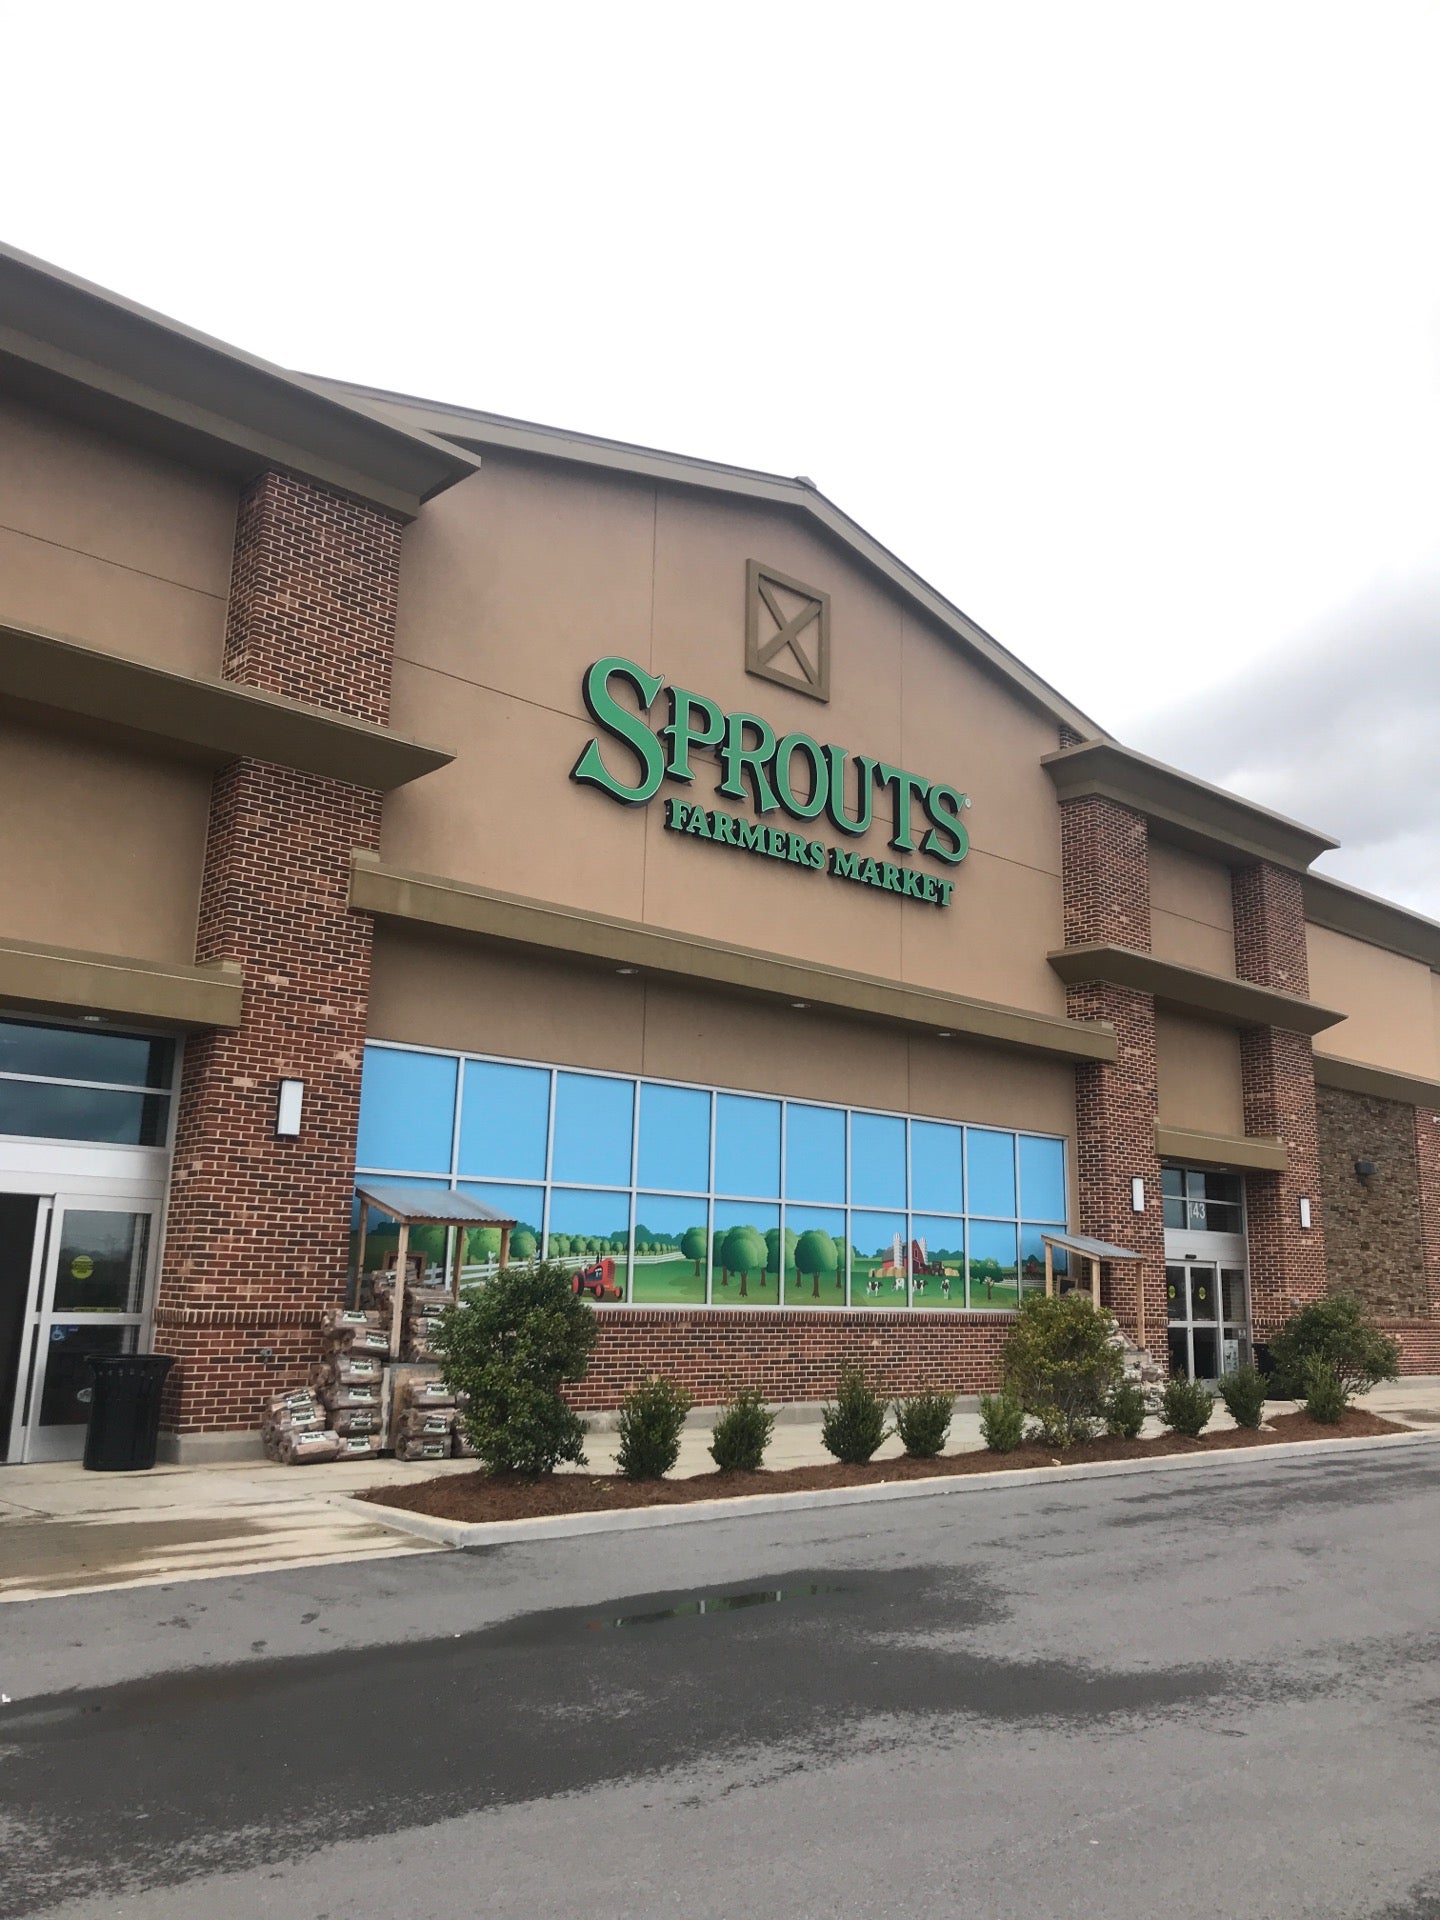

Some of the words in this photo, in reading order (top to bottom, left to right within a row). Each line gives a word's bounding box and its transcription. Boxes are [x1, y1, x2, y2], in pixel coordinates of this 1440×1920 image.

[569, 656, 970, 864] SPROUTS
[664, 797, 826, 869] FARMERS
[828, 847, 955, 907] MARKET
[1189, 1202, 1206, 1219] 143
